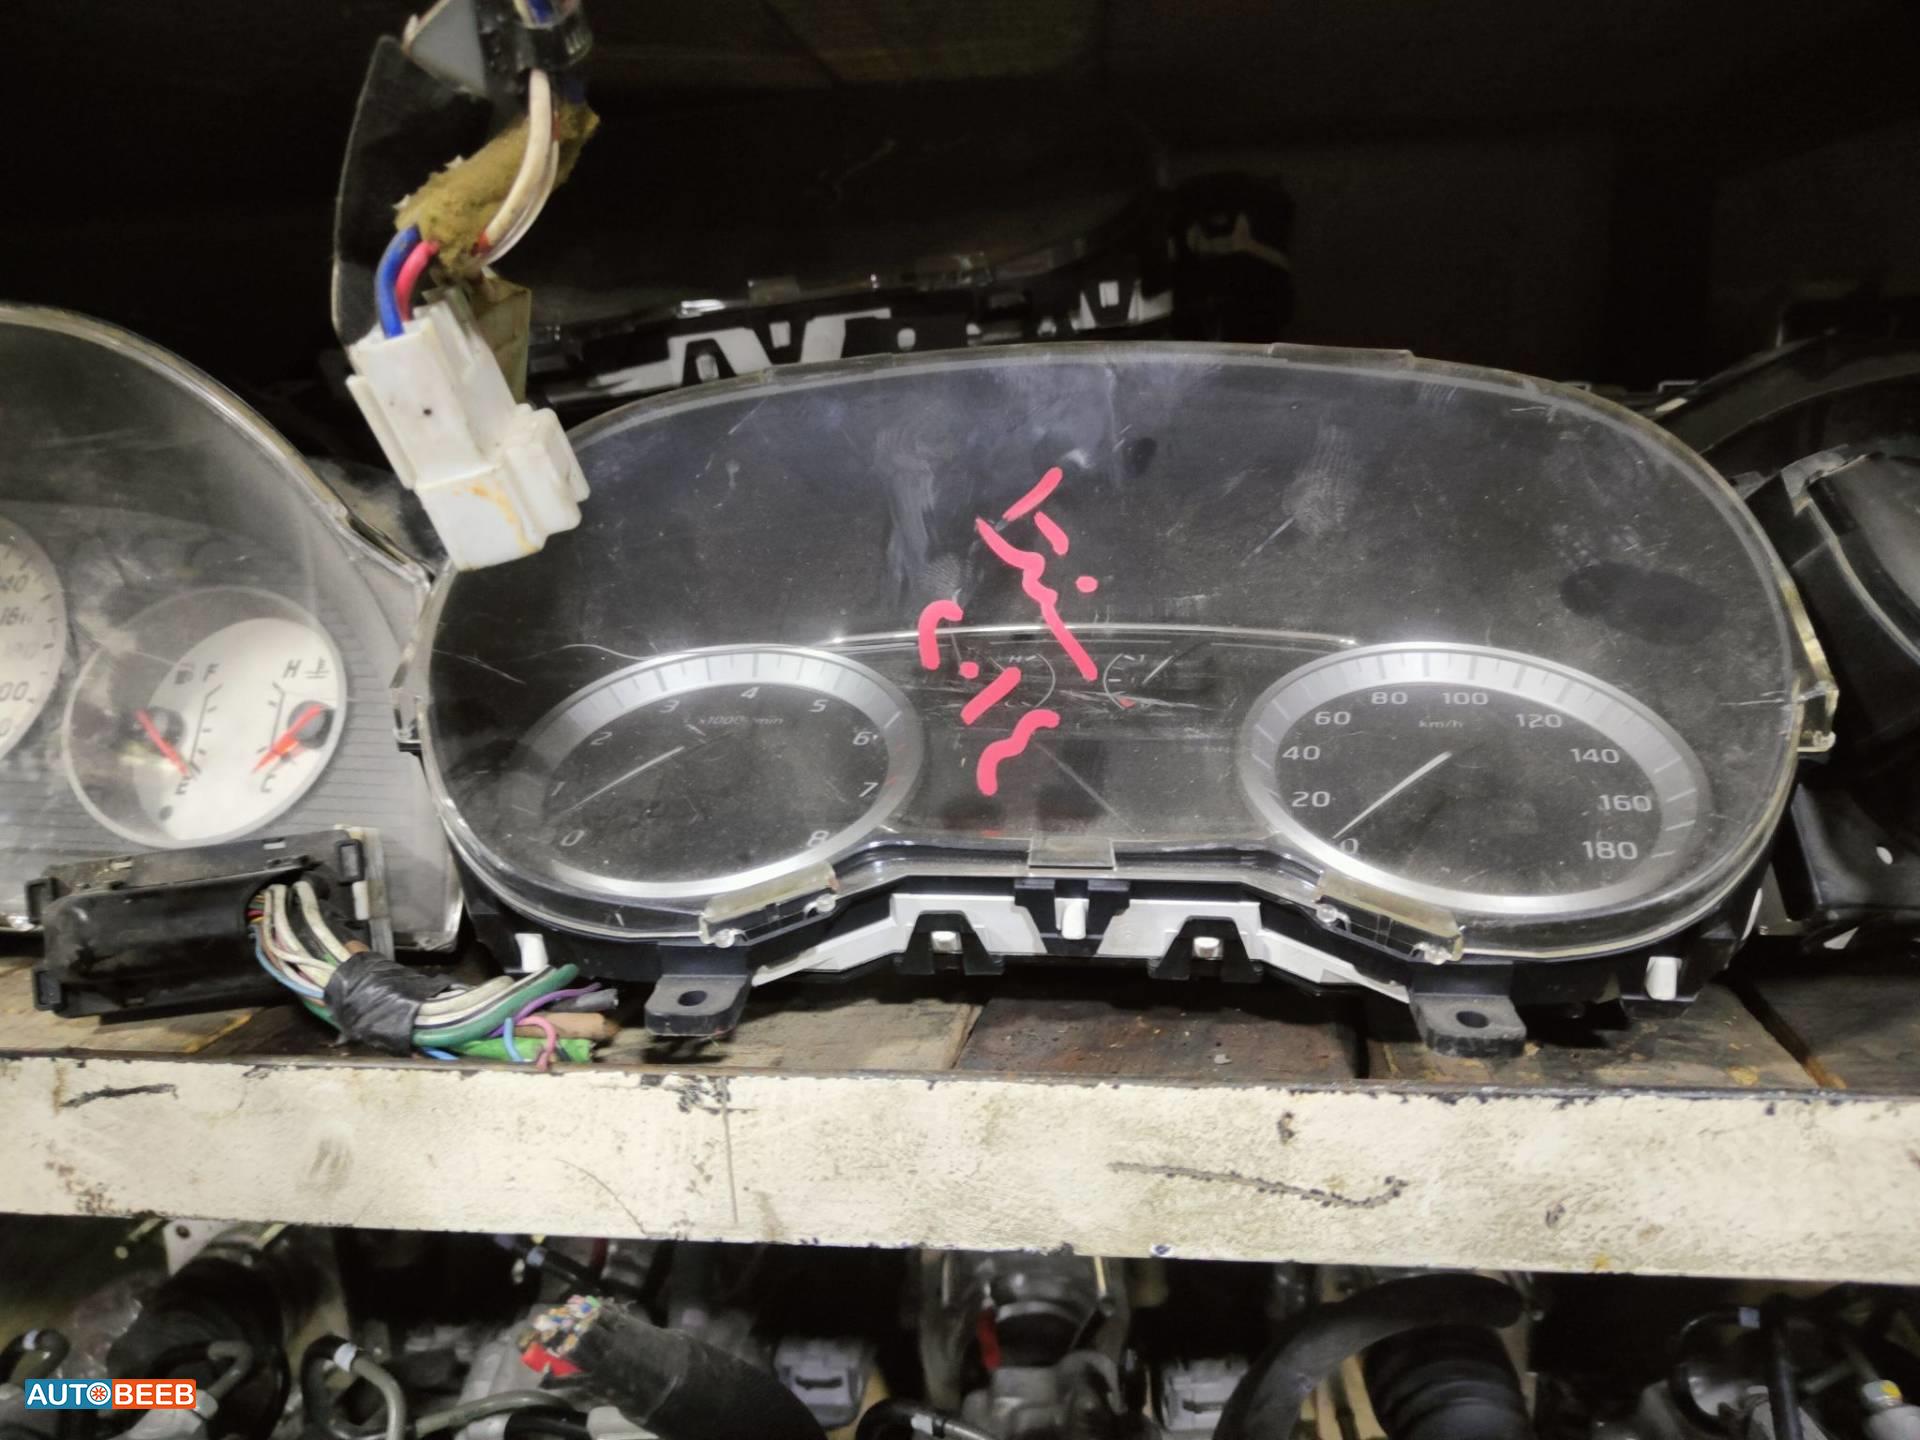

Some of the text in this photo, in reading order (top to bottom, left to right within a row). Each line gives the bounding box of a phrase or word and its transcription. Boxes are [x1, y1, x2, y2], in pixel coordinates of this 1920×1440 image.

[203, 663, 219, 682] F
[283, 659, 302, 679] H
[741, 687, 759, 700] 4
[1371, 691, 1408, 705] 80
[1442, 692, 1489, 706] 100
[661, 701, 681, 713] 3
[809, 700, 827, 713] 5
[1314, 711, 1351, 726] 60
[1418, 719, 1464, 729] km/h
[1516, 713, 1562, 729] 120
[591, 732, 613, 746] 2
[853, 731, 871, 746] 6
[1283, 745, 1321, 761] 40
[1570, 747, 1620, 764] 140
[260, 774, 275, 793] C
[551, 780, 565, 797] 1
[859, 782, 878, 798] 7
[1291, 791, 1331, 808] 20
[1599, 795, 1652, 813] 160
[561, 831, 584, 846] 0
[807, 831, 830, 847] 8
[1340, 838, 1359, 855] 0
[1583, 840, 1638, 861] 180
